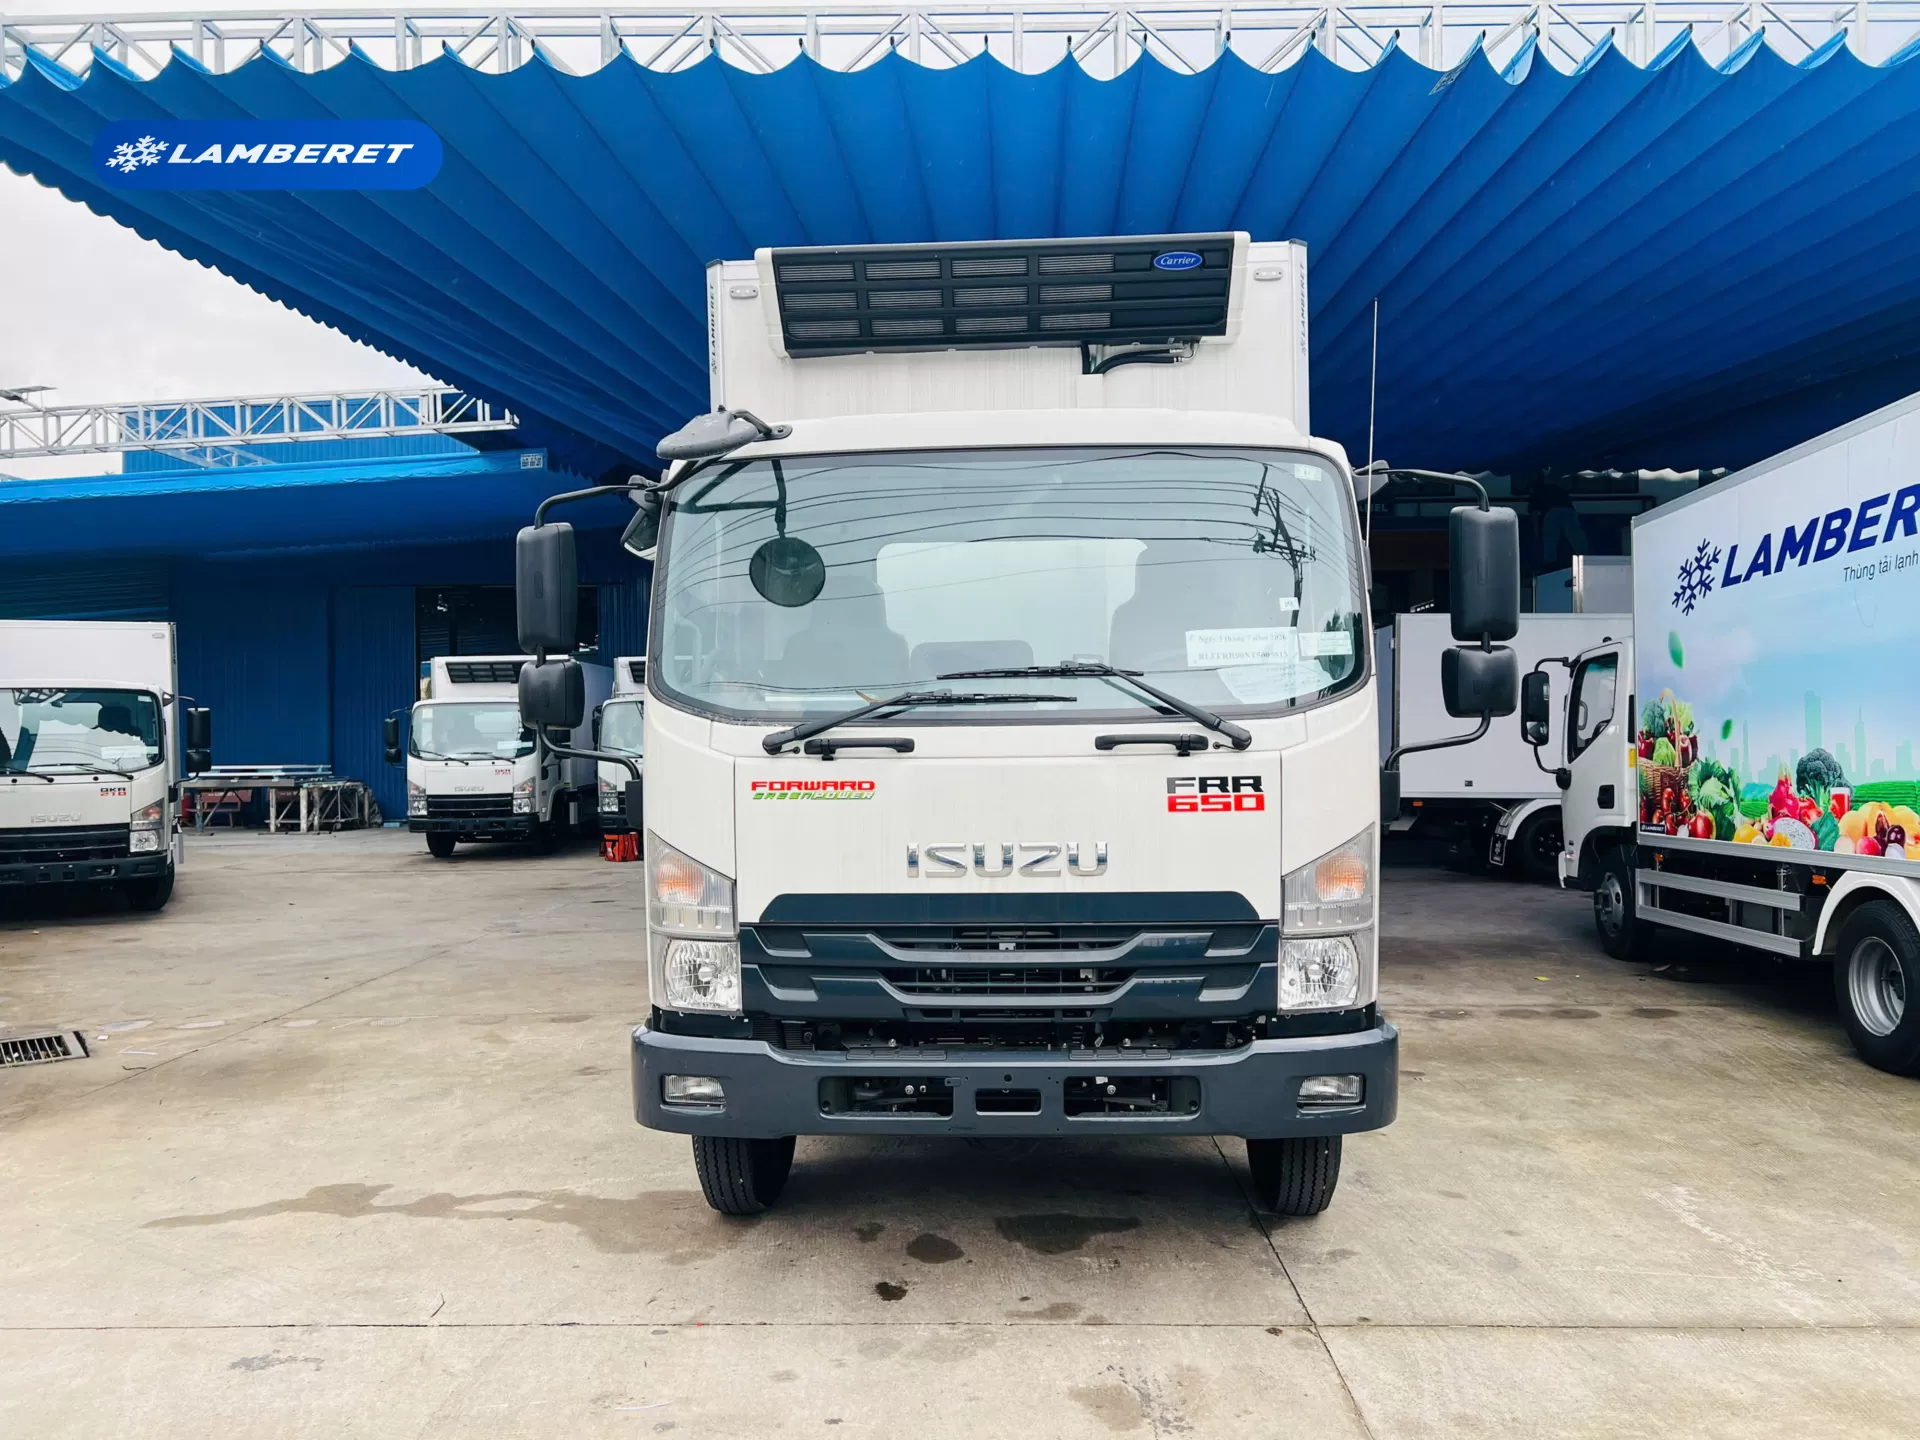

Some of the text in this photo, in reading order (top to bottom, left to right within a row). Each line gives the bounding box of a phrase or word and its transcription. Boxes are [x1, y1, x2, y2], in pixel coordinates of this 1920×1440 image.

[1160, 256, 1197, 265] Carrier
[1720, 483, 1920, 588] LAMBER
[1844, 550, 1919, 582] Thùng tải lạnh
[751, 781, 876, 791] FORWARD
[1166, 775, 1264, 794] FRR
[1167, 794, 1265, 812] 650
[30, 812, 82, 824] ISUZU
[906, 842, 1108, 878] ISUZU
